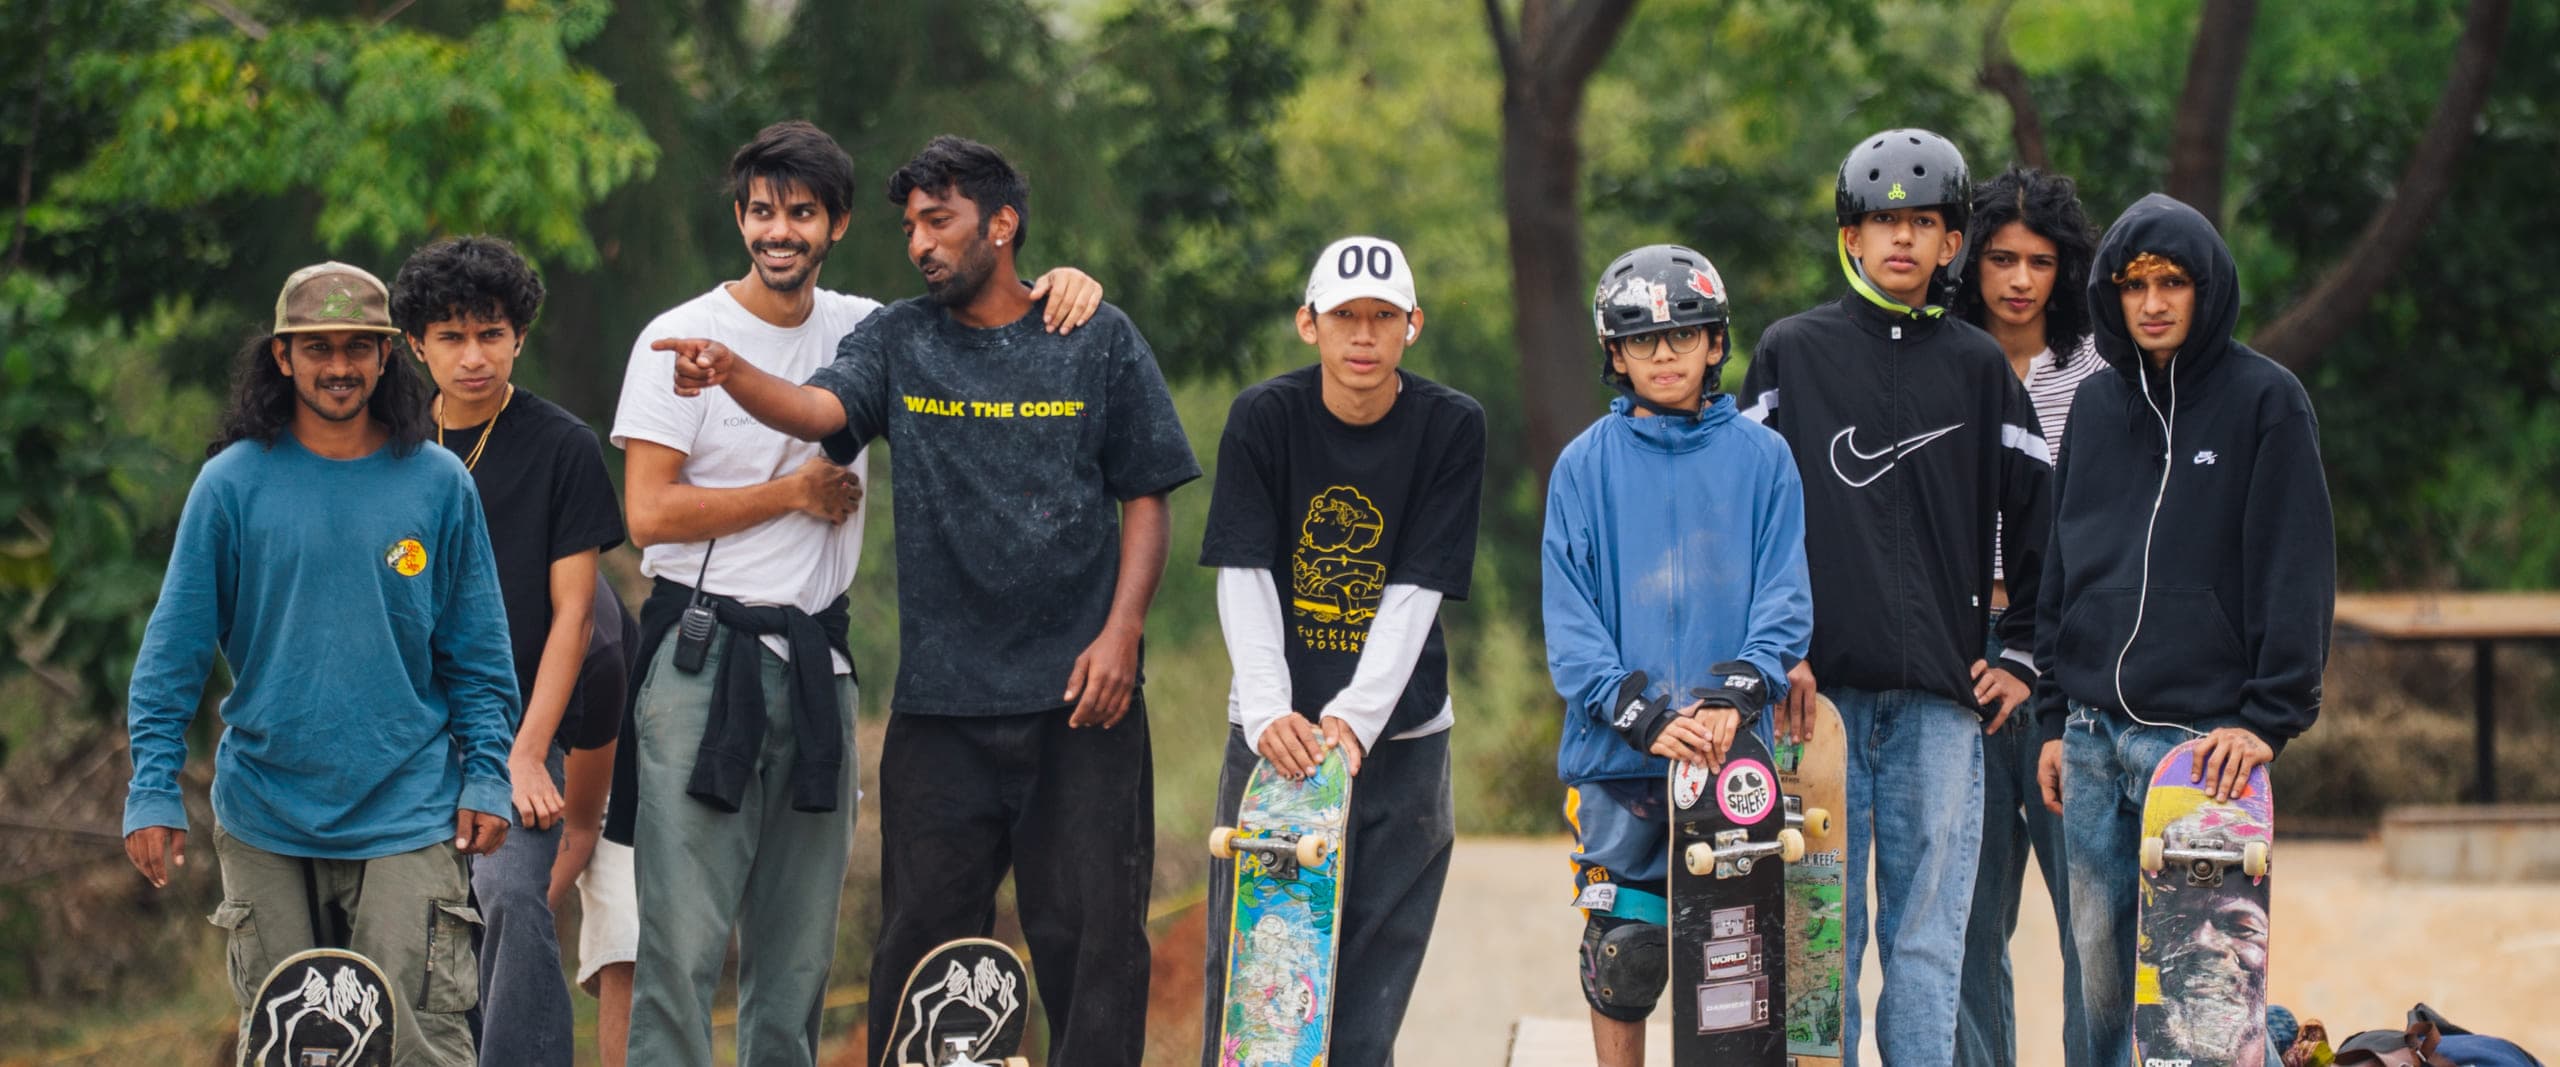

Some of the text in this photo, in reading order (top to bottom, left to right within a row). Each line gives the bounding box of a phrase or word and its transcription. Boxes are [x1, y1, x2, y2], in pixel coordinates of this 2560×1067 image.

[1338, 245, 1392, 280] 00
[971, 401, 1014, 418] THE
[1297, 625, 1369, 641] FUCKING
[1306, 639, 1359, 654] POSER
[1727, 787, 1768, 814] SPHERE
[1711, 951, 1748, 965] WORLD
